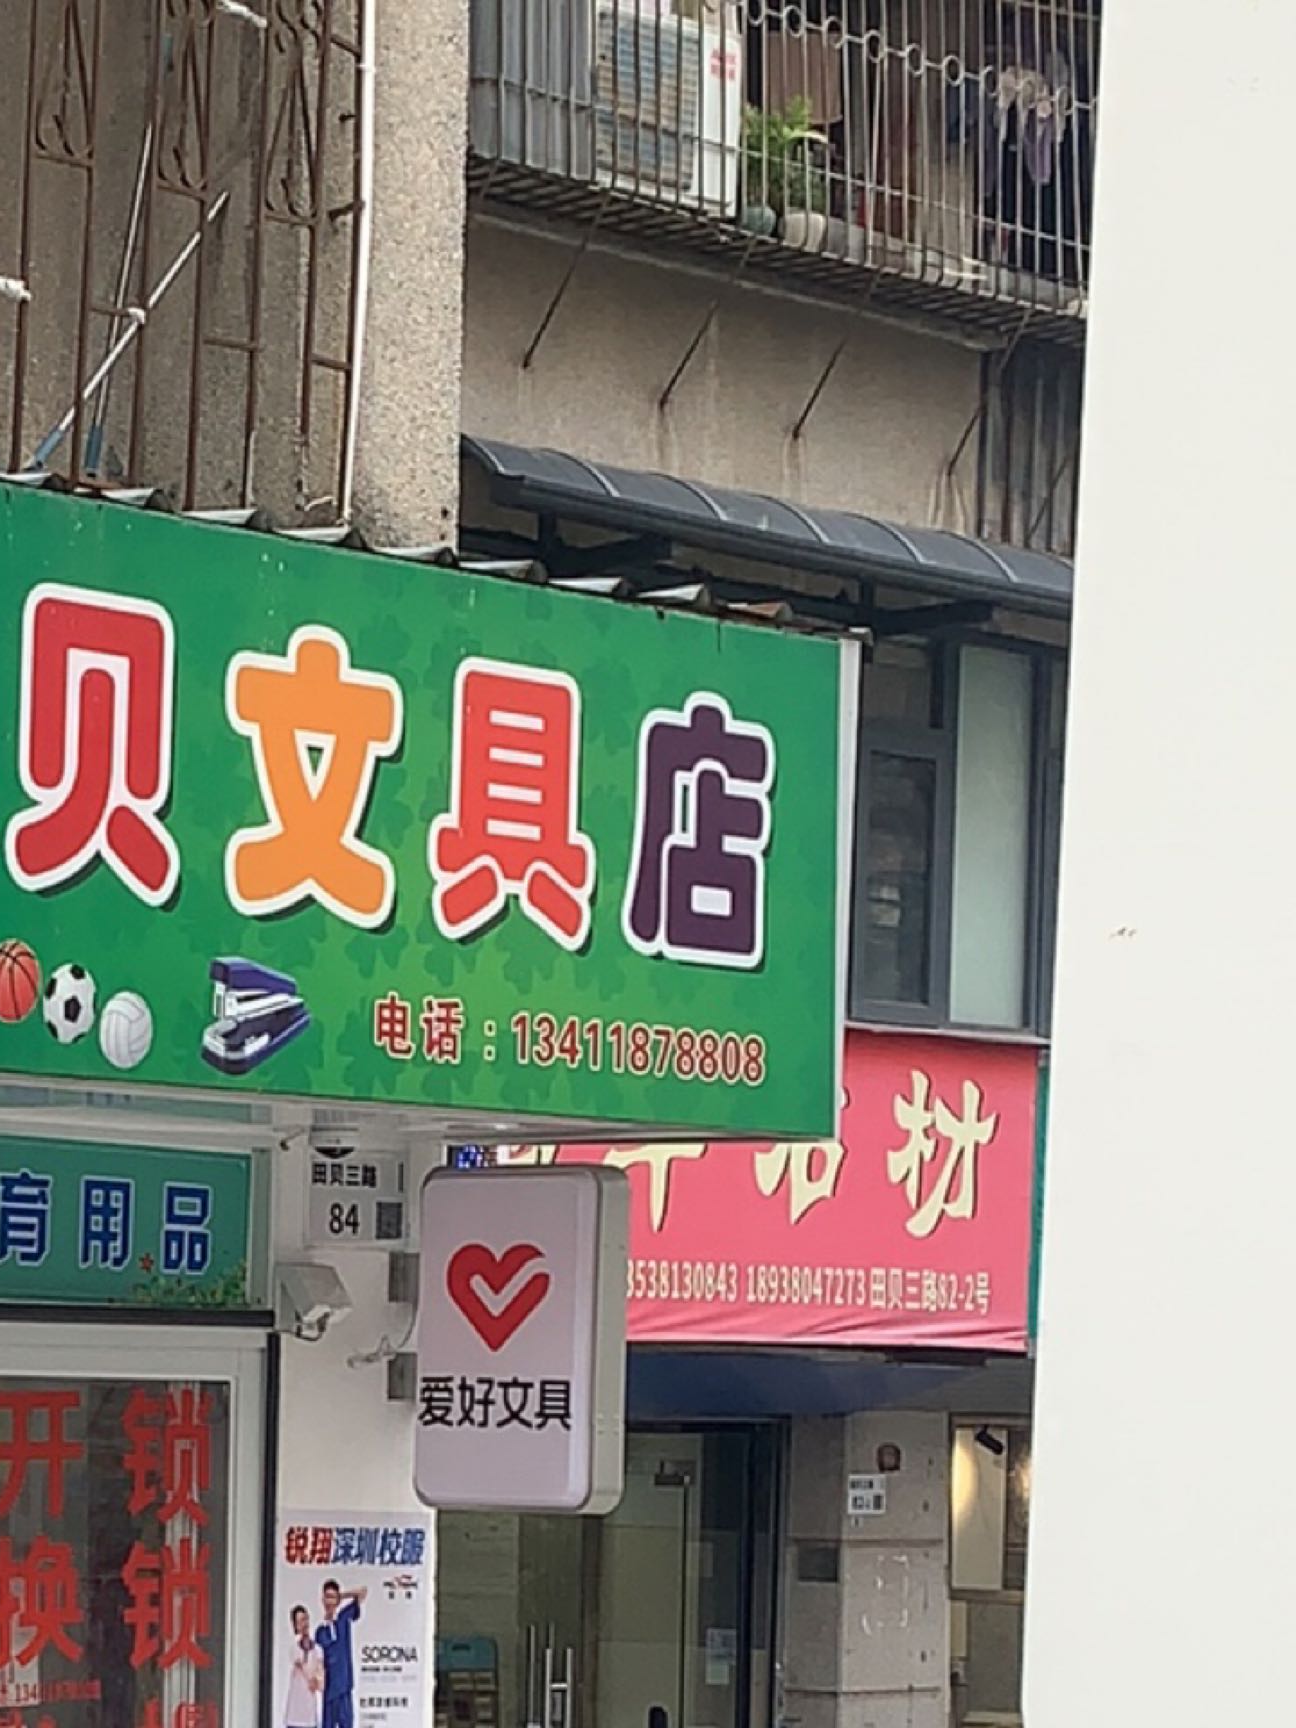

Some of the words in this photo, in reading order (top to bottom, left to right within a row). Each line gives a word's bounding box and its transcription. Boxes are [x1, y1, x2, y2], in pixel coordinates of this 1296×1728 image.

[329, 1203, 361, 1235] 84
[417, 1375, 572, 1431] 爱好文具
[361, 1645, 418, 1664] SORONA
